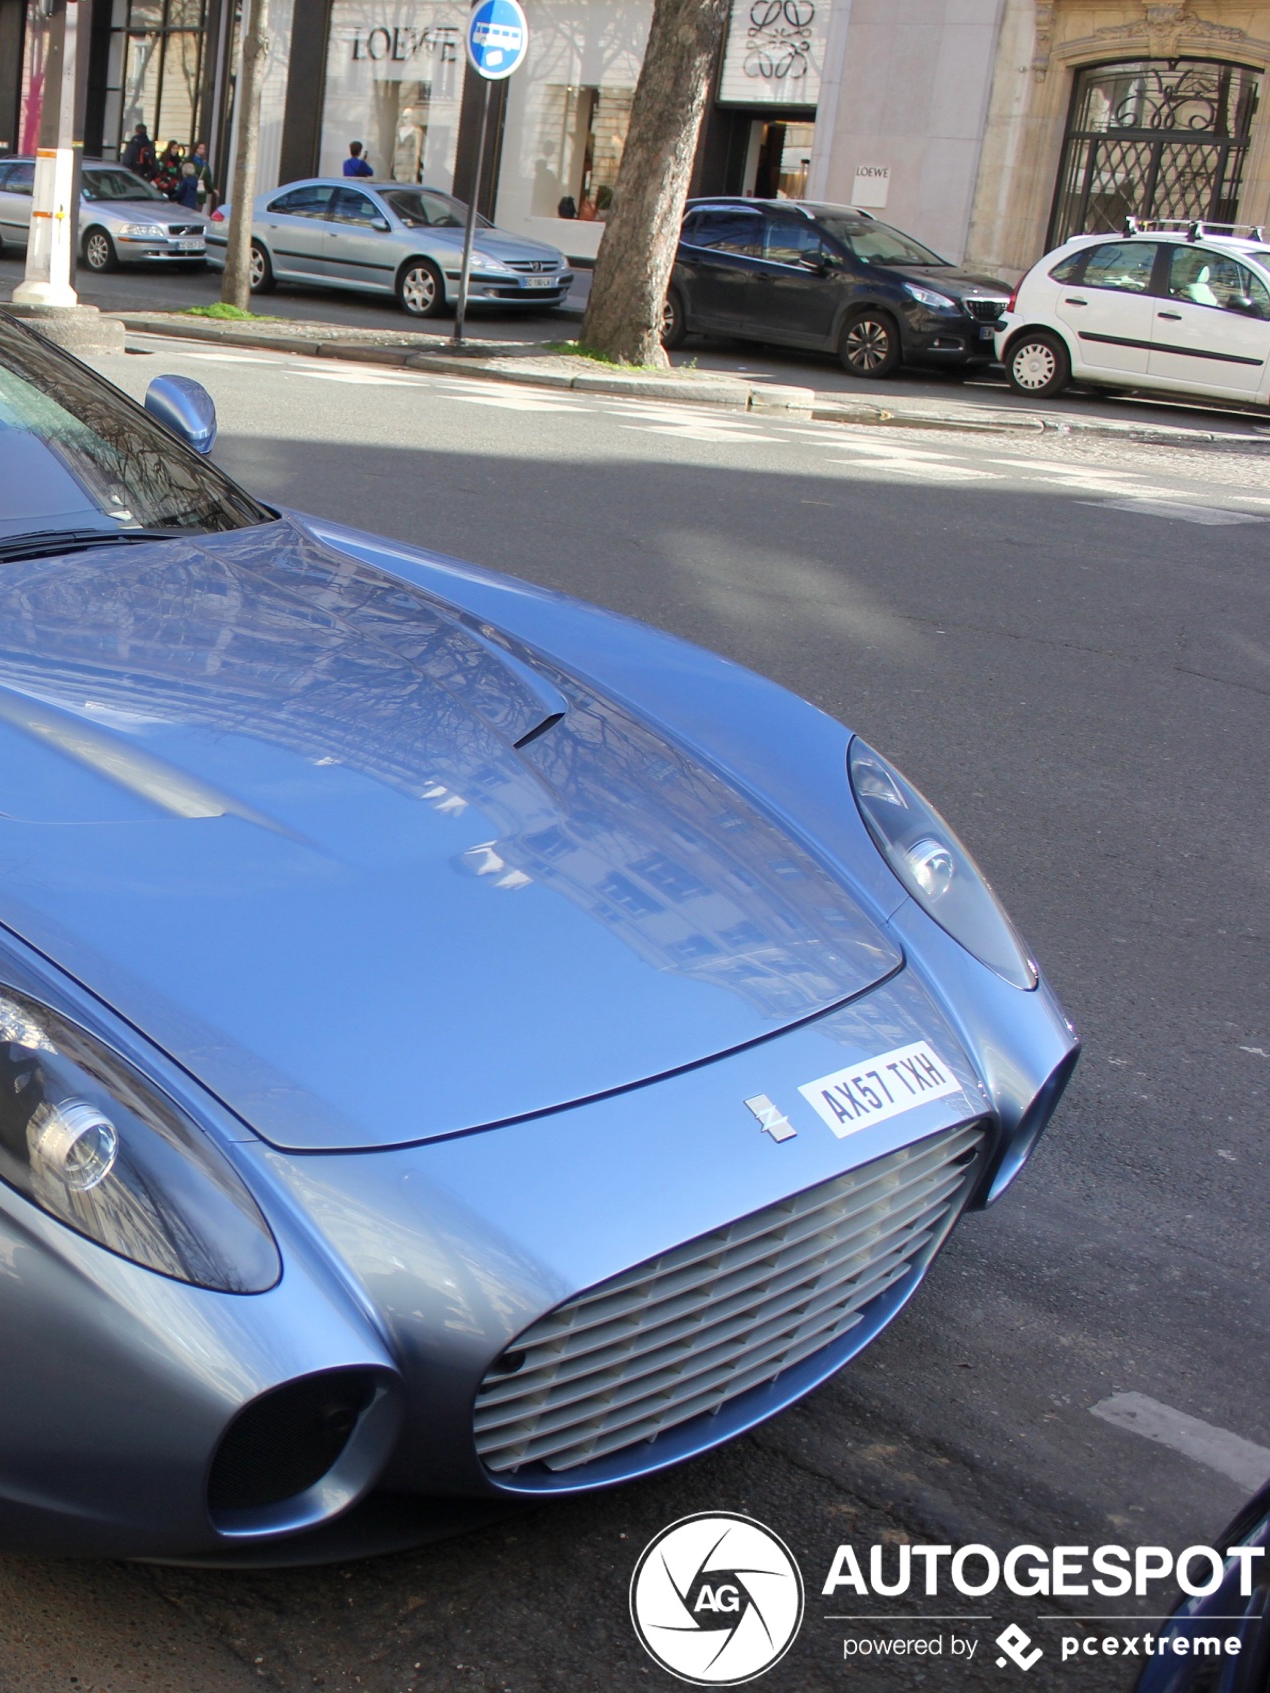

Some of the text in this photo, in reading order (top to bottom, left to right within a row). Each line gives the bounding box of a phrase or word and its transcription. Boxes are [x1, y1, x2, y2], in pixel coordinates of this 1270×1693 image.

[351, 26, 459, 62] LOEWE
[856, 166, 889, 178] LOEWE
[821, 1052, 946, 1124] AX57 TXH
